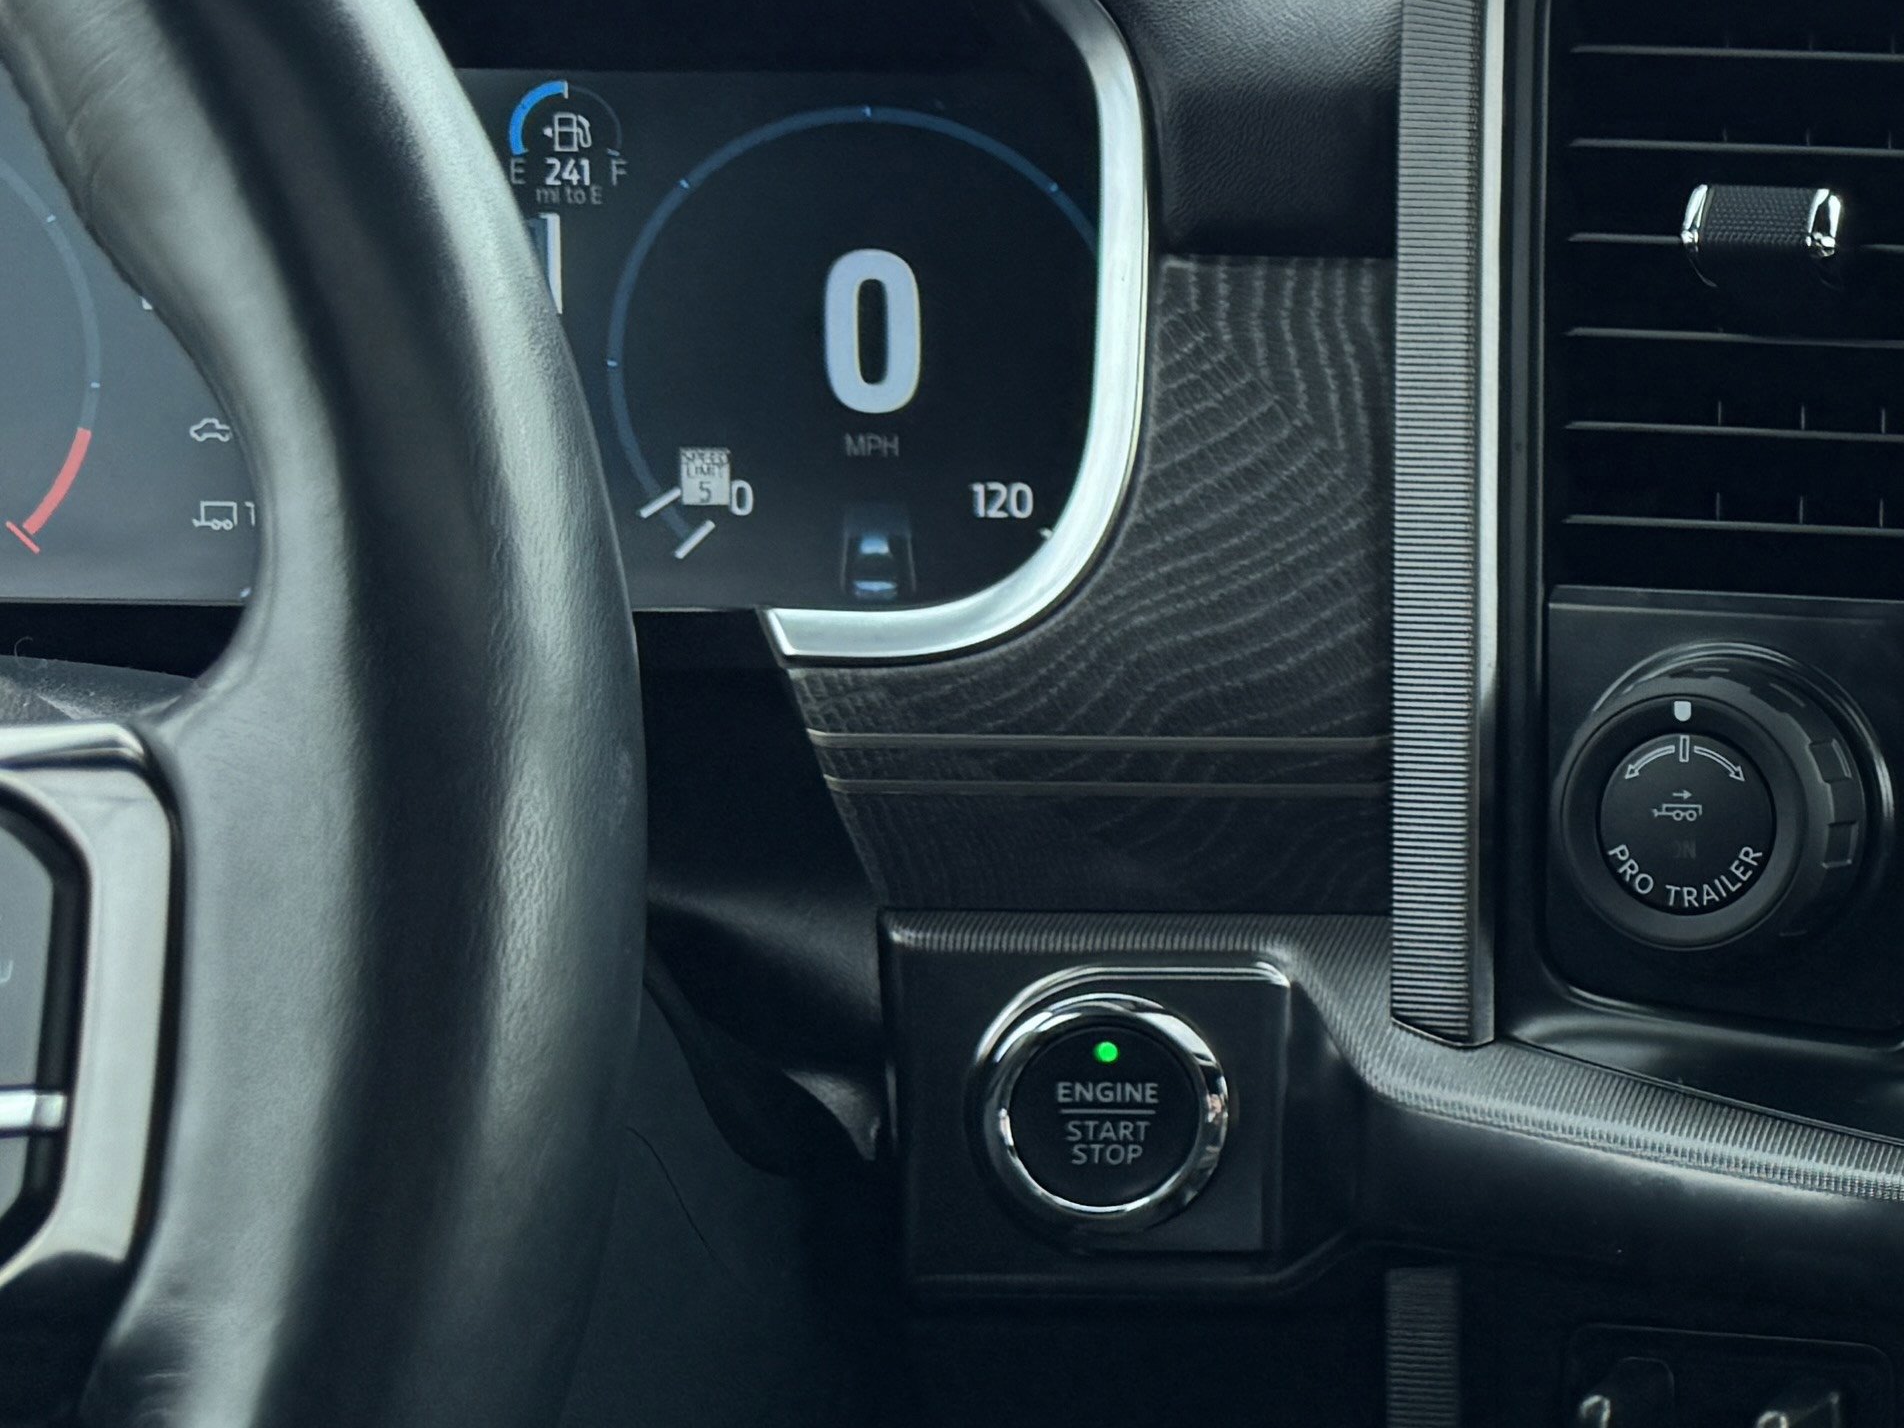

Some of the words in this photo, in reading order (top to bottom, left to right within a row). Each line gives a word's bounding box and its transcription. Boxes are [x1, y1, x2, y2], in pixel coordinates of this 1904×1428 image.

[545, 158, 590, 185] 241
[611, 159, 628, 186] F
[565, 187, 582, 204] to
[591, 186, 603, 204] E
[824, 249, 921, 413] 0
[846, 434, 899, 457] MPH
[699, 482, 712, 503] 5
[970, 482, 1033, 518] 120
[1607, 844, 1654, 896] PRO
[1665, 846, 1762, 909] TRAILER
[1057, 1083, 1159, 1105] ENGINE
[1066, 1120, 1149, 1143] START
[1072, 1143, 1143, 1167] STOP
